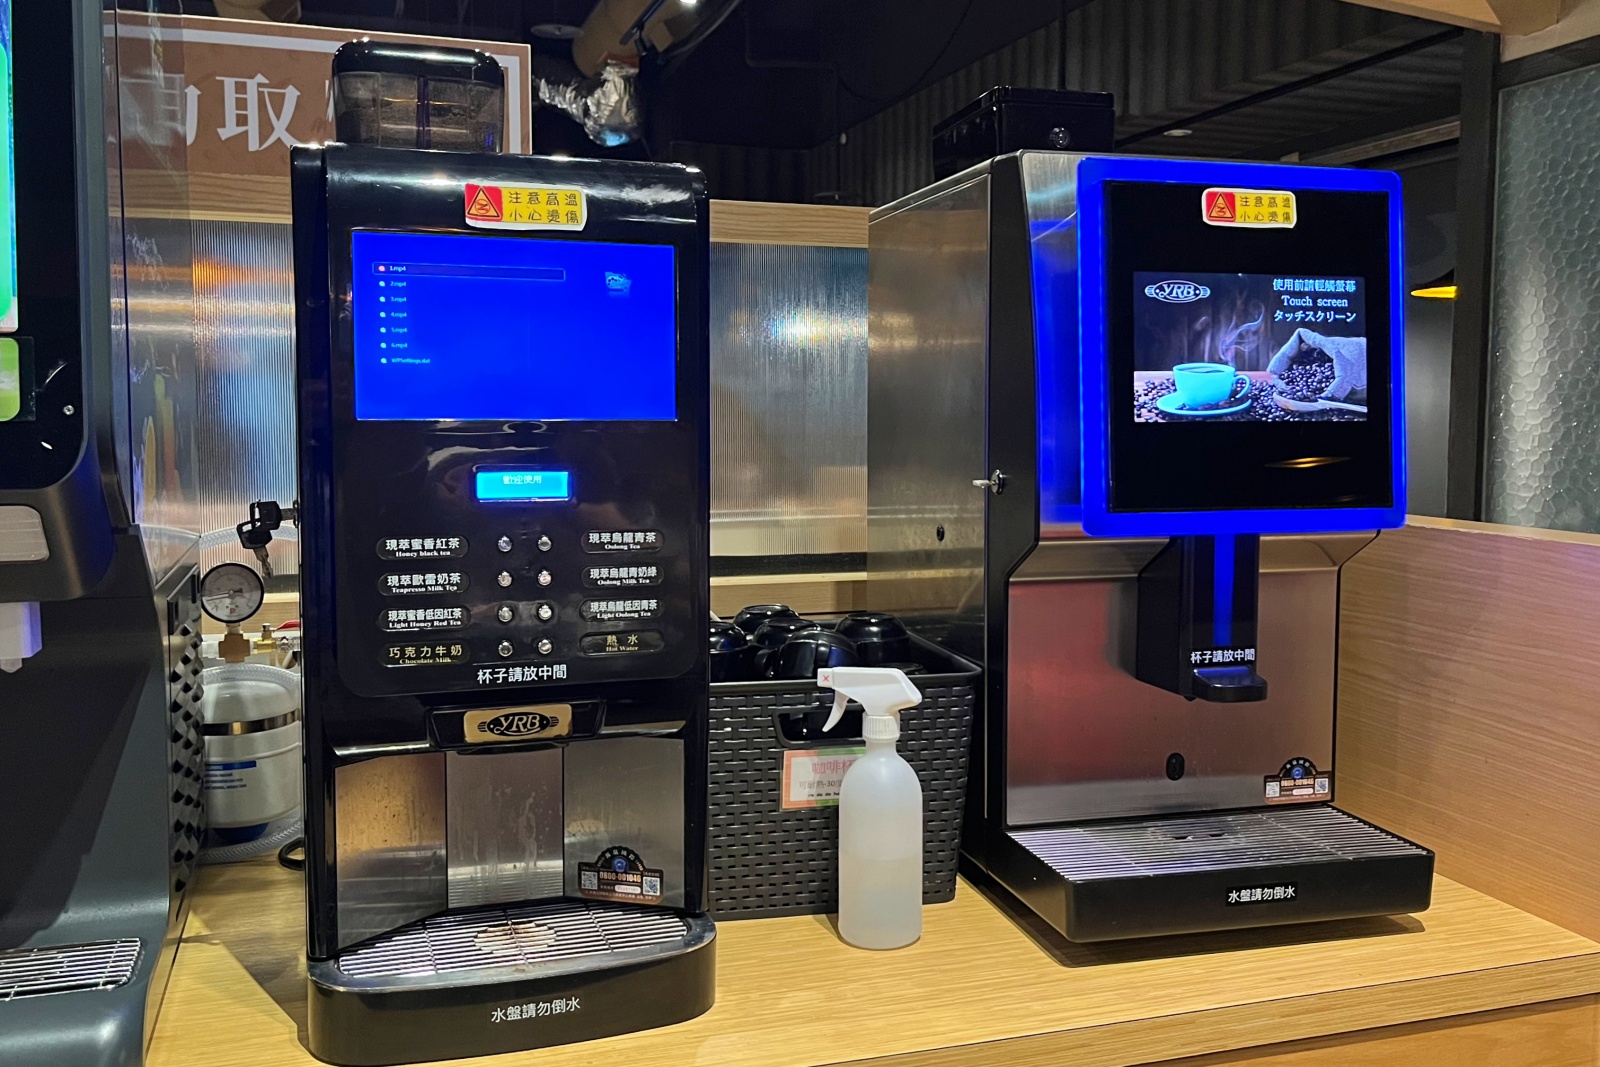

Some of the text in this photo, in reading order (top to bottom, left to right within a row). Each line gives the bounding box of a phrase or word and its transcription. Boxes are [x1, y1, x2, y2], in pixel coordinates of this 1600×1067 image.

[508, 191, 578, 207] 注意高溫
[509, 208, 579, 224] 小心燙傷
[1158, 283, 1196, 300] YRB
[1281, 295, 1348, 307] Touch screen
[1273, 310, 1357, 322] タッチスクリーン
[385, 537, 460, 551] 現萃蜜香紅茶
[588, 532, 657, 544] 現萃烏龍青茶
[388, 644, 463, 658] 巧克力牛奶
[1190, 648, 1256, 664] 杯子請放中間
[476, 663, 567, 685] 杯子請放中間
[493, 714, 542, 735] YRB
[1227, 885, 1296, 903] 水盤請勿倒水
[490, 996, 581, 1023] 水盤請勿倒水
